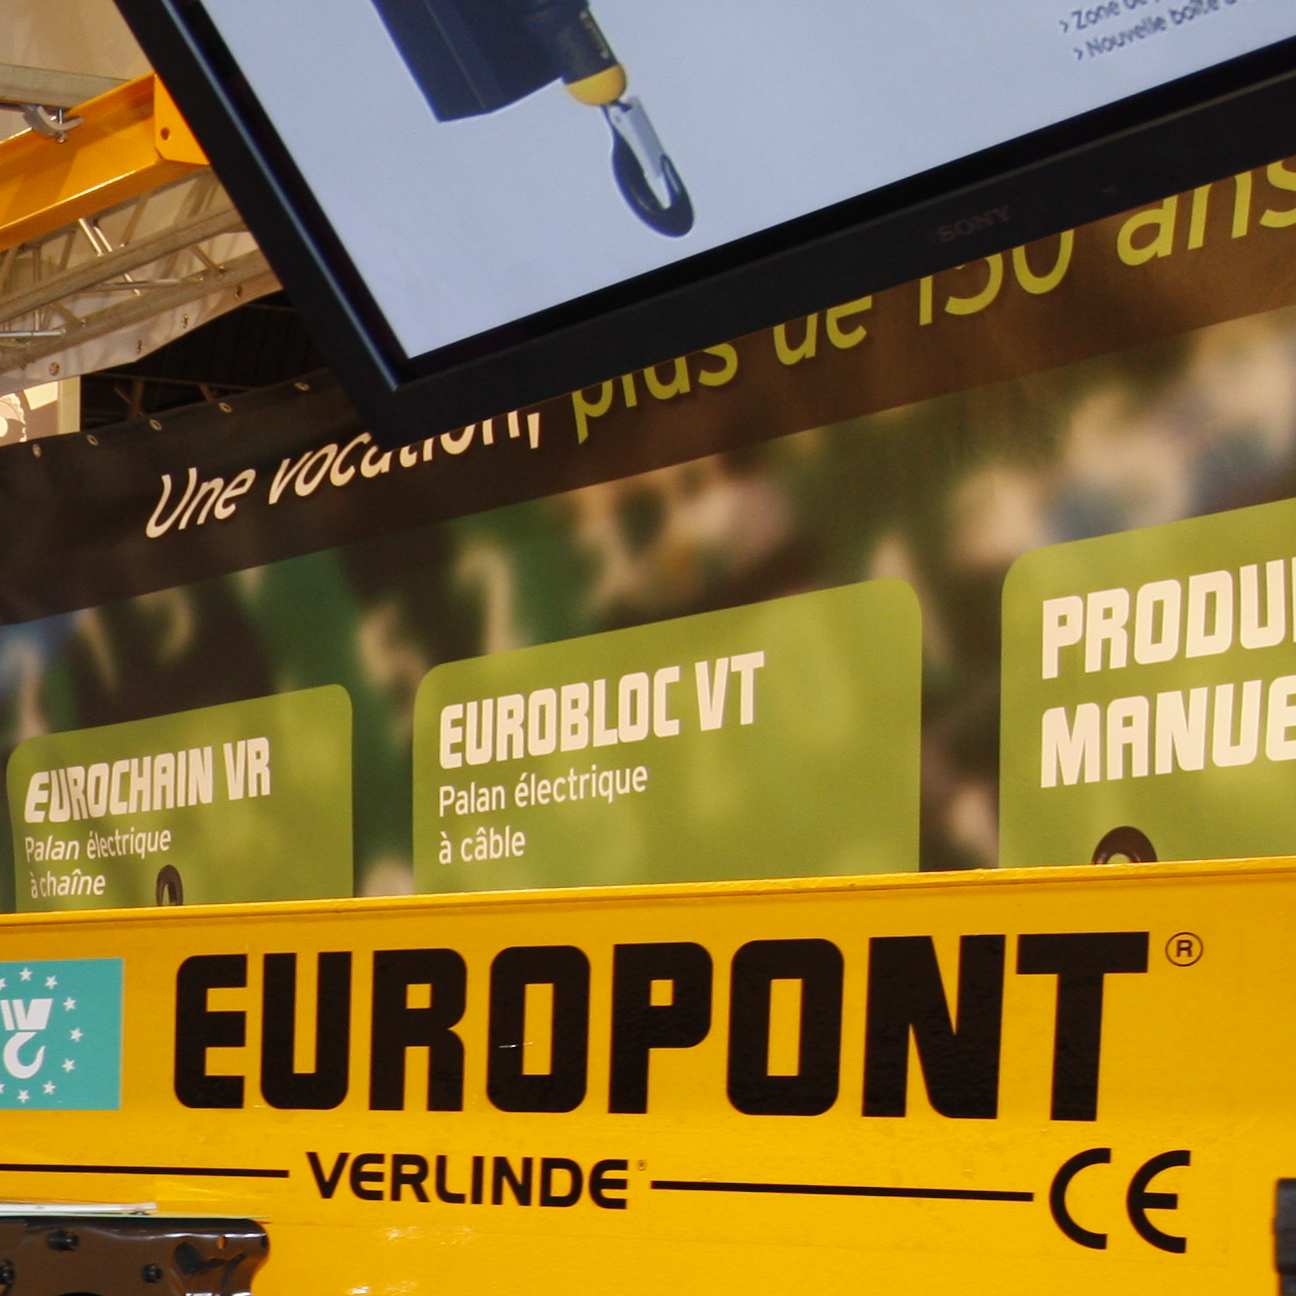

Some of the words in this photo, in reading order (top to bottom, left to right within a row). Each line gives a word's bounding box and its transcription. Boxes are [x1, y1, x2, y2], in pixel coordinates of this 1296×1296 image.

[936, 205, 1010, 241] SONY
[145, 466, 257, 539] Une
[1042, 556, 1296, 680] PRODU
[439, 664, 681, 770] EUROBLOC
[694, 650, 765, 732] VT
[24, 745, 214, 824] EUROCHAIN
[223, 736, 272, 801] VR
[439, 781, 506, 818] Palan
[514, 764, 649, 809] électrique
[24, 834, 81, 863] Palan
[86, 826, 172, 860] électrique
[439, 831, 452, 865] à
[460, 825, 527, 863] câble
[30, 871, 39, 899] à
[39, 869, 107, 897] chaîne
[172, 930, 1151, 1122] EUROPONT
[306, 1151, 630, 1210] VERLINDE
[1050, 1147, 1193, 1255] CE
